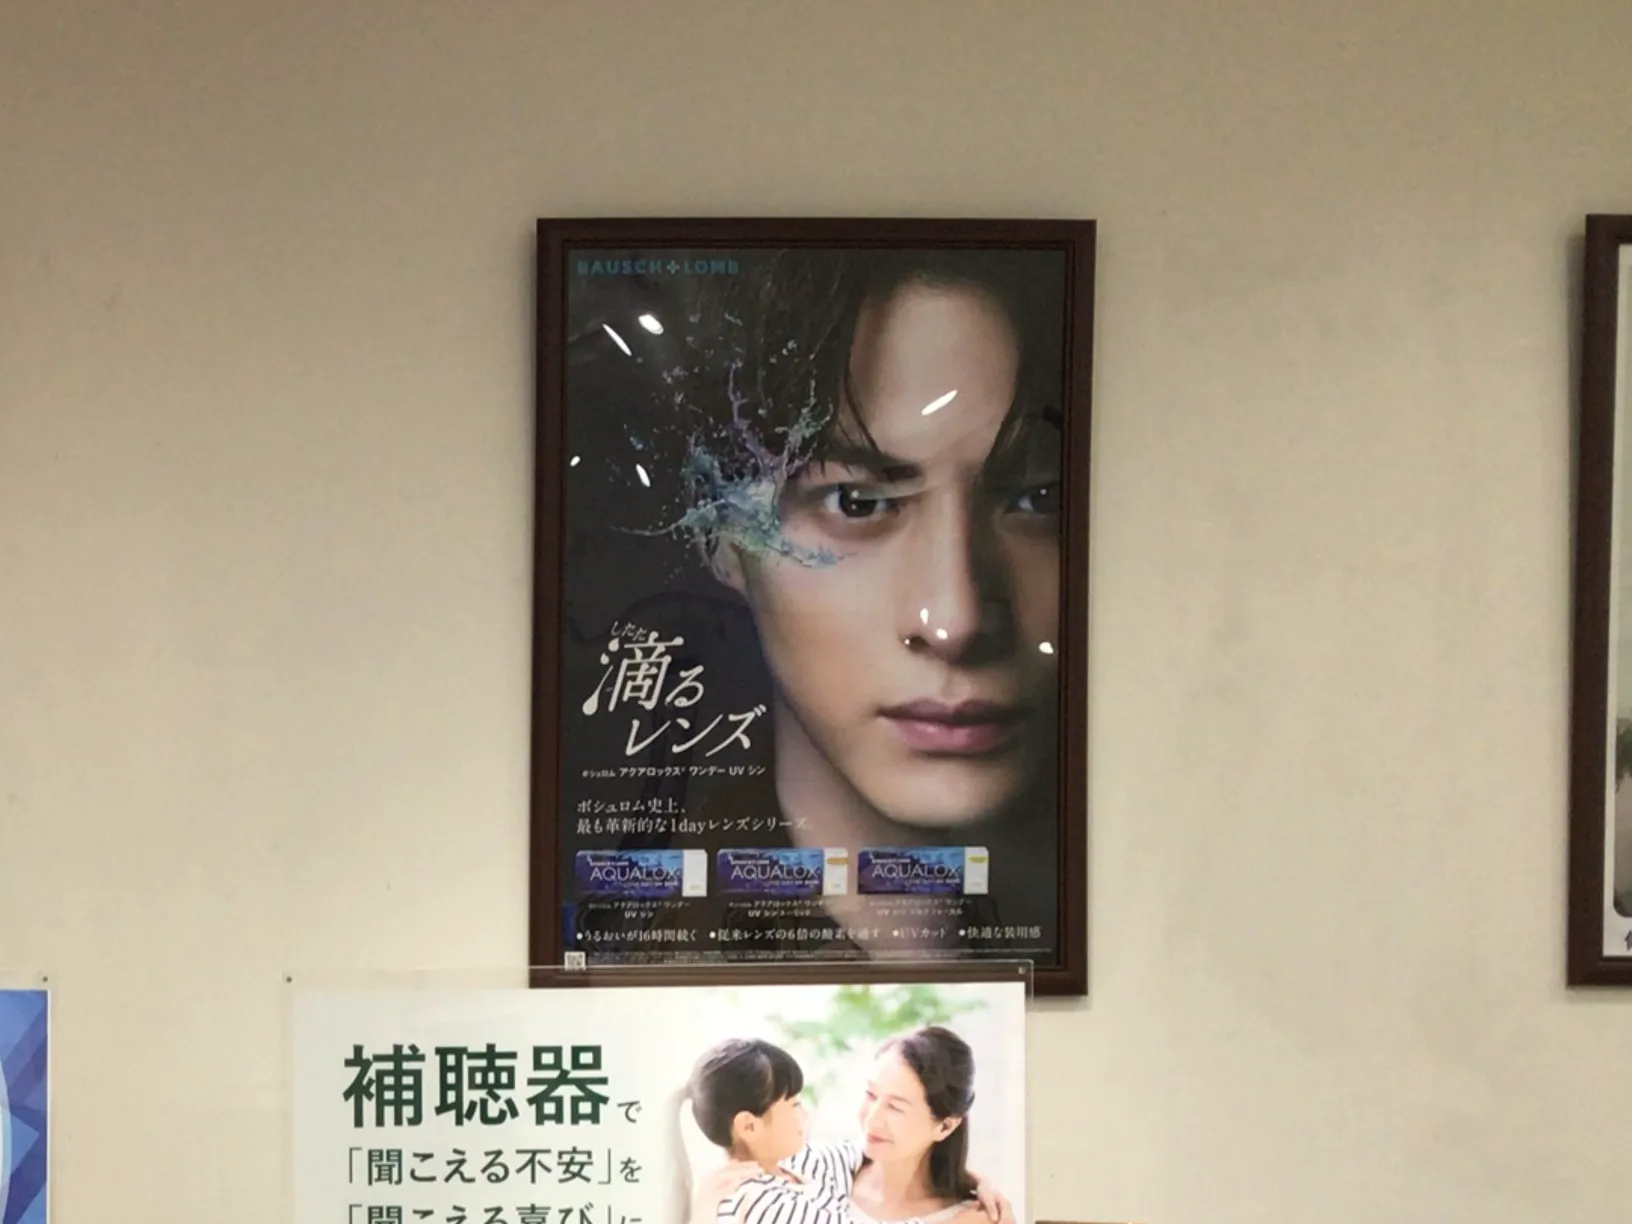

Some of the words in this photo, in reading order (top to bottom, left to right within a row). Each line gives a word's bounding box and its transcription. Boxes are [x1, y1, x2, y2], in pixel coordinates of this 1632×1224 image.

[581, 633, 705, 715] 滴る
[625, 704, 767, 757] レンズ
[689, 766, 725, 777] ワンデー
[729, 766, 744, 777] UV
[577, 799, 688, 815] ボシュロム史上、
[590, 866, 682, 881] AQUALOX
[731, 864, 820, 880] AQUALOX
[872, 864, 961, 880] AQUALOX
[346, 1146, 642, 1185] 「聞こえる不安」を
